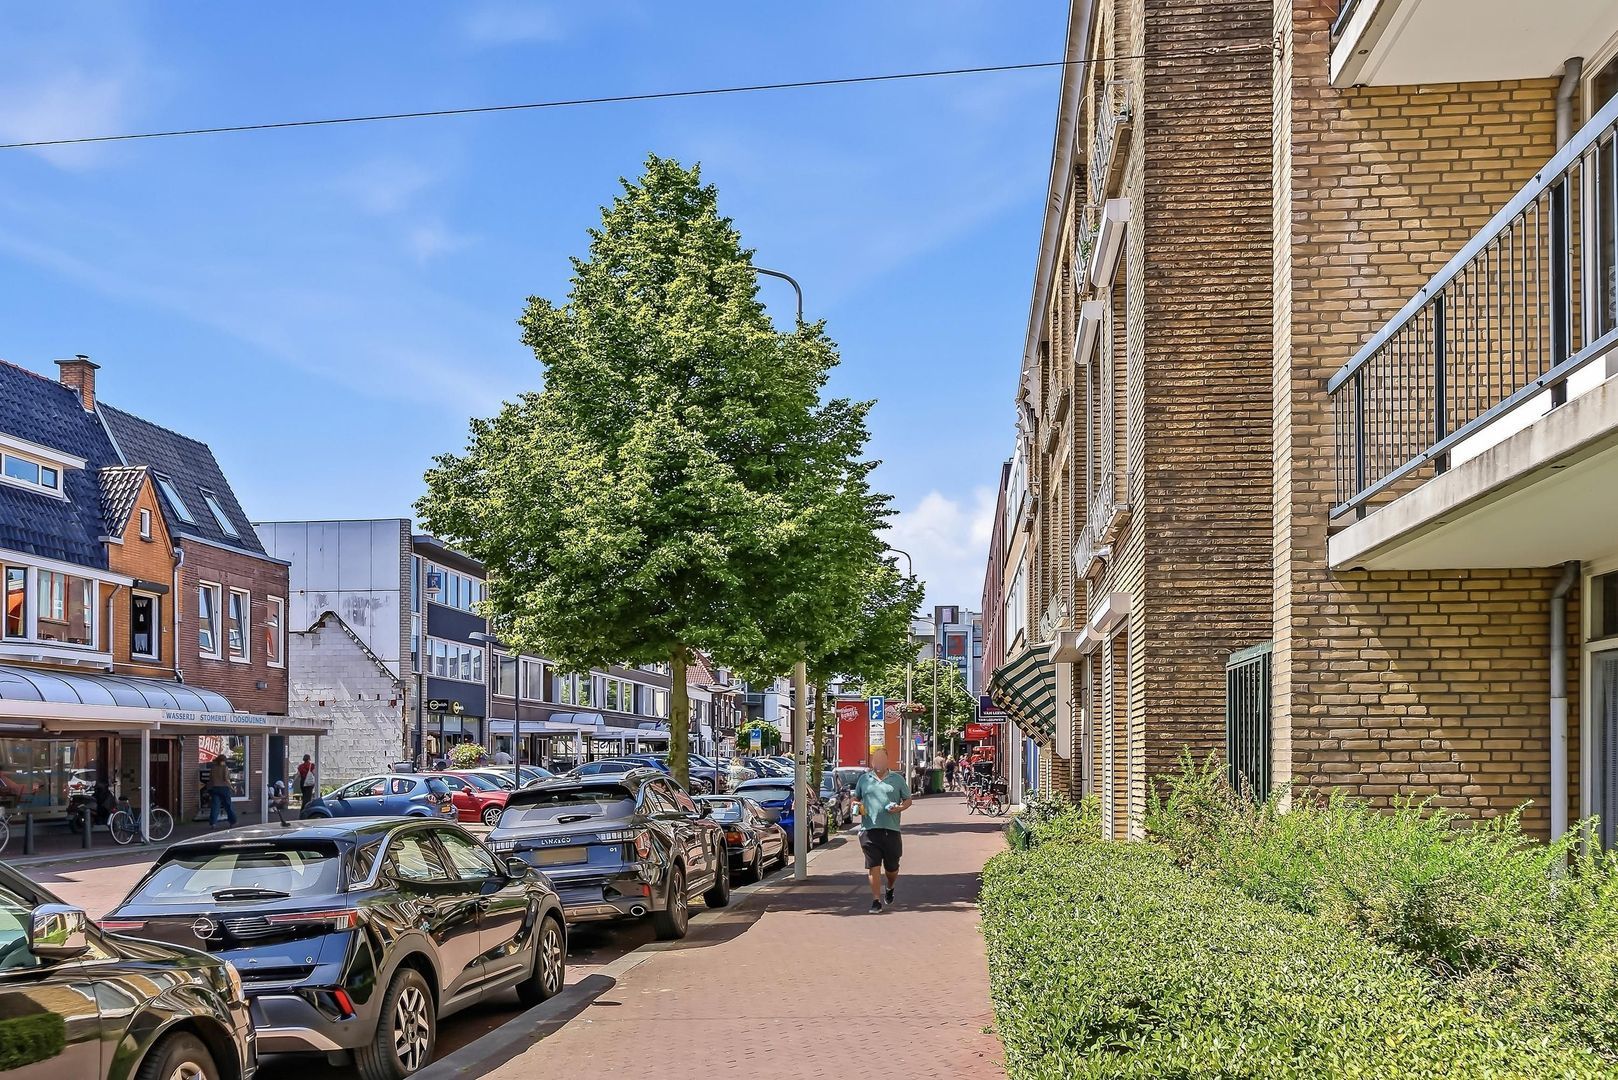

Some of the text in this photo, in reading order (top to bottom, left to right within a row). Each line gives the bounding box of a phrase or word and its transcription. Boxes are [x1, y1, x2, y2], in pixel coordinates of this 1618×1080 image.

[872, 698, 881, 711] P
[166, 712, 267, 724] WASSERIJ STOMERIJ LOOSDUINEN
